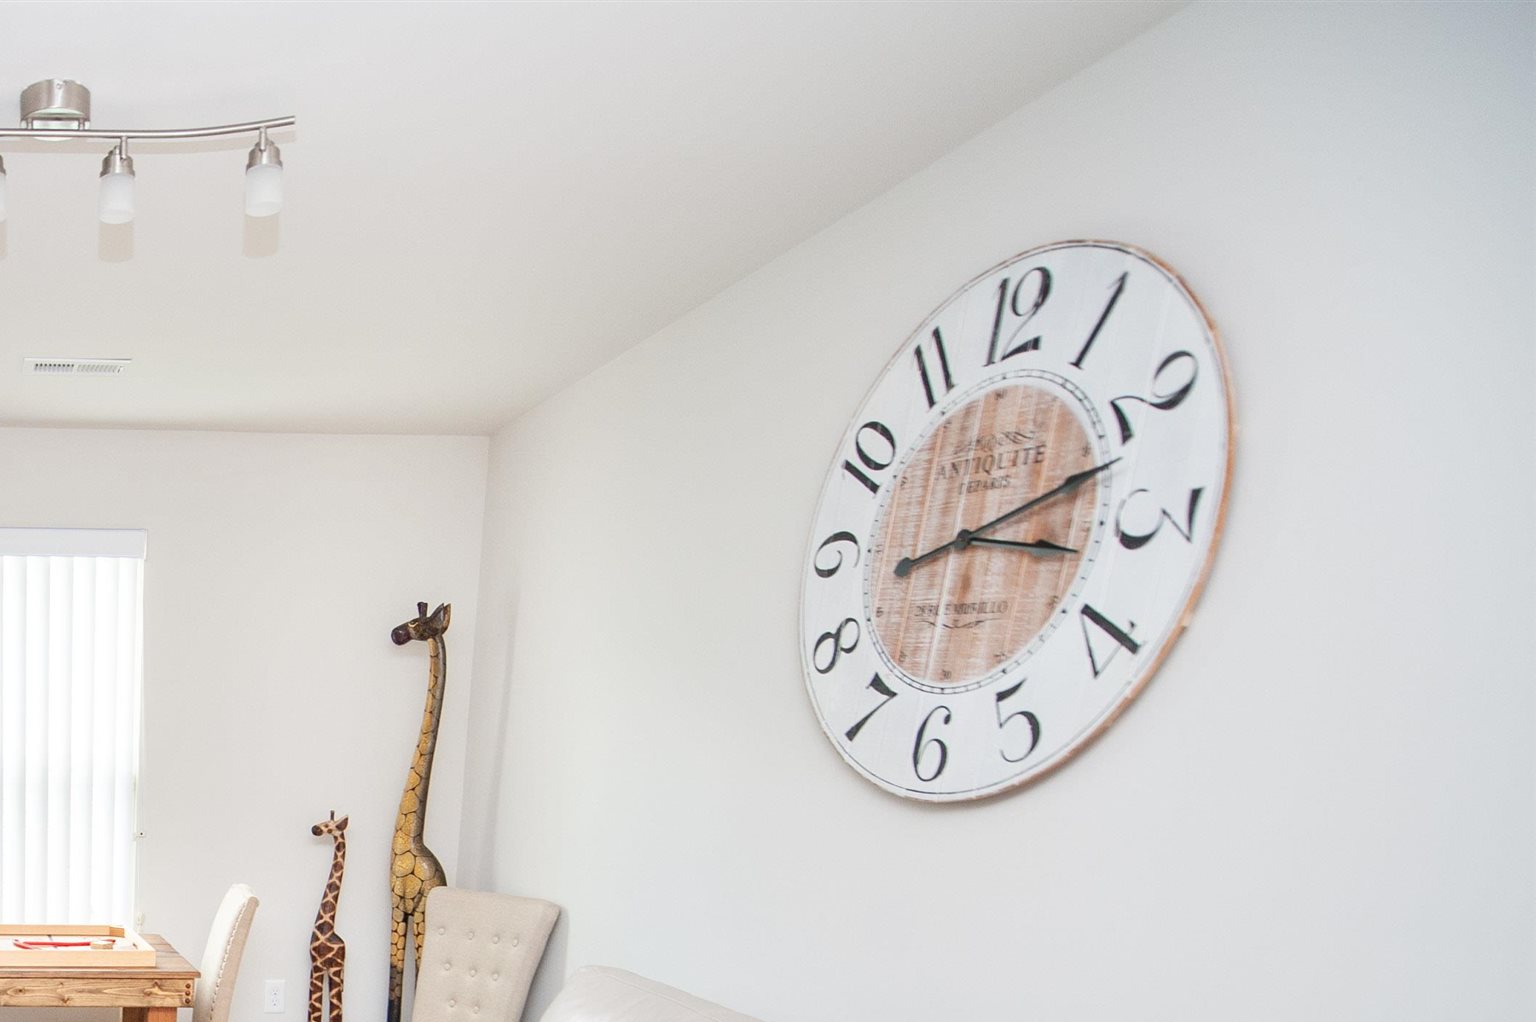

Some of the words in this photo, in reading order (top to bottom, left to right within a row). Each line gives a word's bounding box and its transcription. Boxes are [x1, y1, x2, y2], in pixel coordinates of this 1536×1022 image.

[983, 265, 1053, 367] 12
[1069, 271, 1129, 370] 1
[914, 324, 955, 409] 11
[1109, 350, 1198, 446] 2
[842, 421, 898, 495] 10
[814, 531, 860, 578] 9
[1114, 487, 1204, 550] 3
[813, 618, 860, 674] 8
[1080, 603, 1146, 679] 4
[845, 672, 898, 741] 7
[912, 705, 951, 782] 6
[995, 678, 1041, 763] 5
